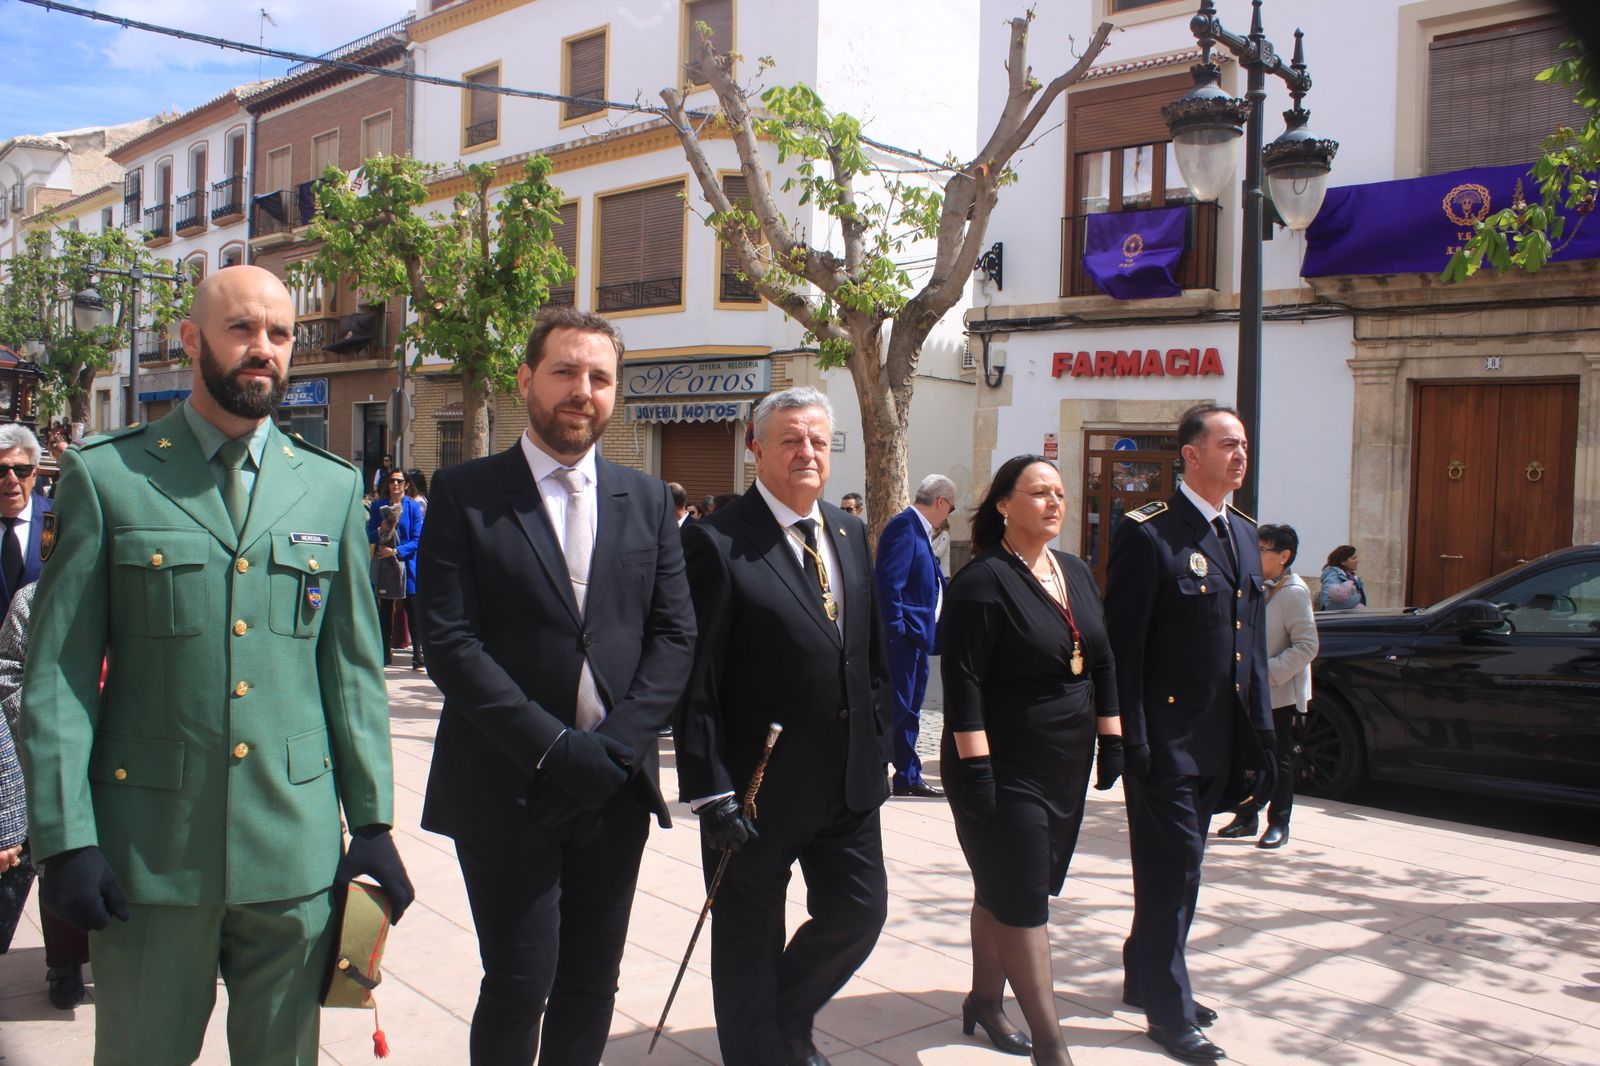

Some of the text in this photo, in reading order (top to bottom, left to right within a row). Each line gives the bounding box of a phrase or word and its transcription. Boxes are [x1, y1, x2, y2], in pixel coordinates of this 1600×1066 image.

[697, 361, 759, 371] JOYERIA RELOJERIA
[1052, 348, 1224, 378] FARMACIA
[629, 365, 756, 394] MOTOS
[636, 404, 737, 420] JOYERIA MOTOS
